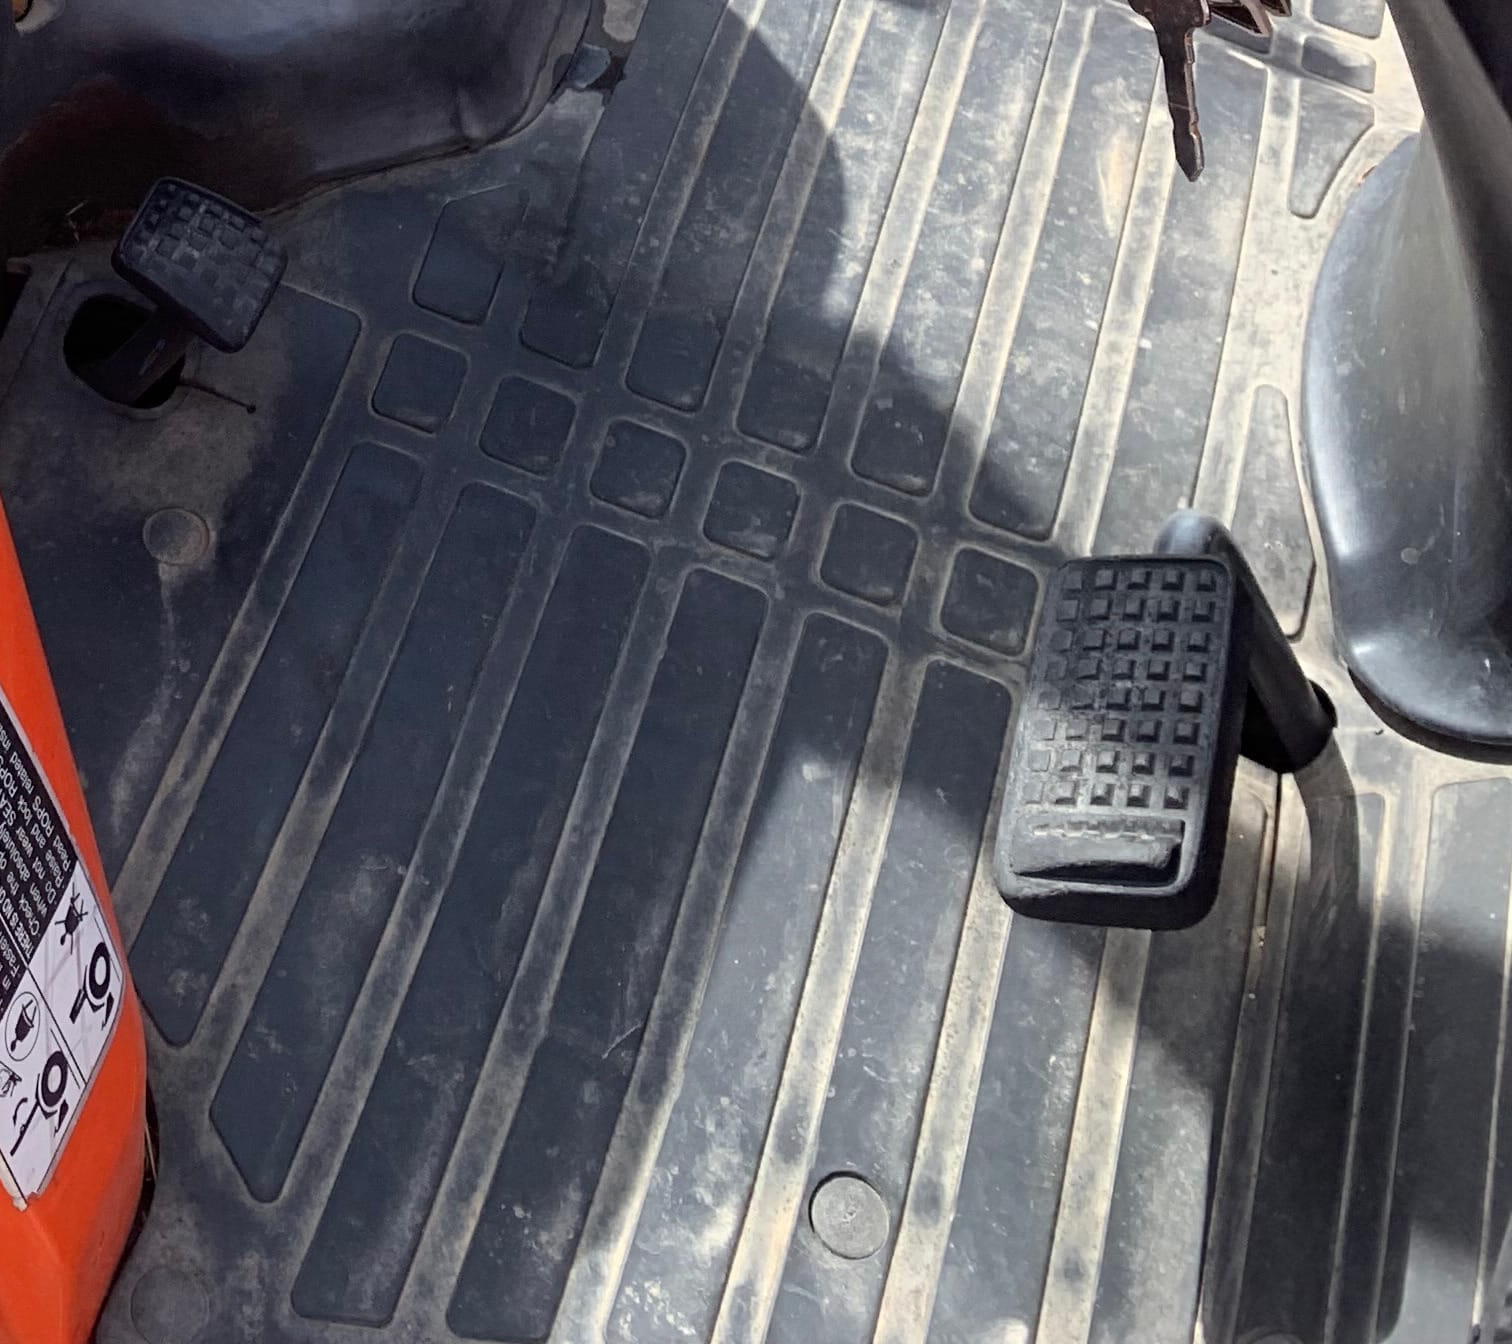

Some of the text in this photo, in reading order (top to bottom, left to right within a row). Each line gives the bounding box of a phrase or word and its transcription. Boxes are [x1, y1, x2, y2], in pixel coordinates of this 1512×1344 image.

[8, 750, 34, 794] related
[17, 794, 33, 826] lock
[31, 795, 54, 838] ROPS
[15, 826, 33, 857] wear
[29, 822, 46, 848] and
[31, 855, 46, 879] not
[45, 849, 64, 888] Raise
[52, 834, 71, 872] Read
[6, 871, 19, 896] the
[44, 880, 56, 904] Do
[1, 897, 14, 919] NO
[18, 893, 39, 935] Check
[29, 882, 47, 917] when
[9, 911, 19, 929] IS
[14, 920, 34, 960] THERE
[1, 974, 11, 994] in
